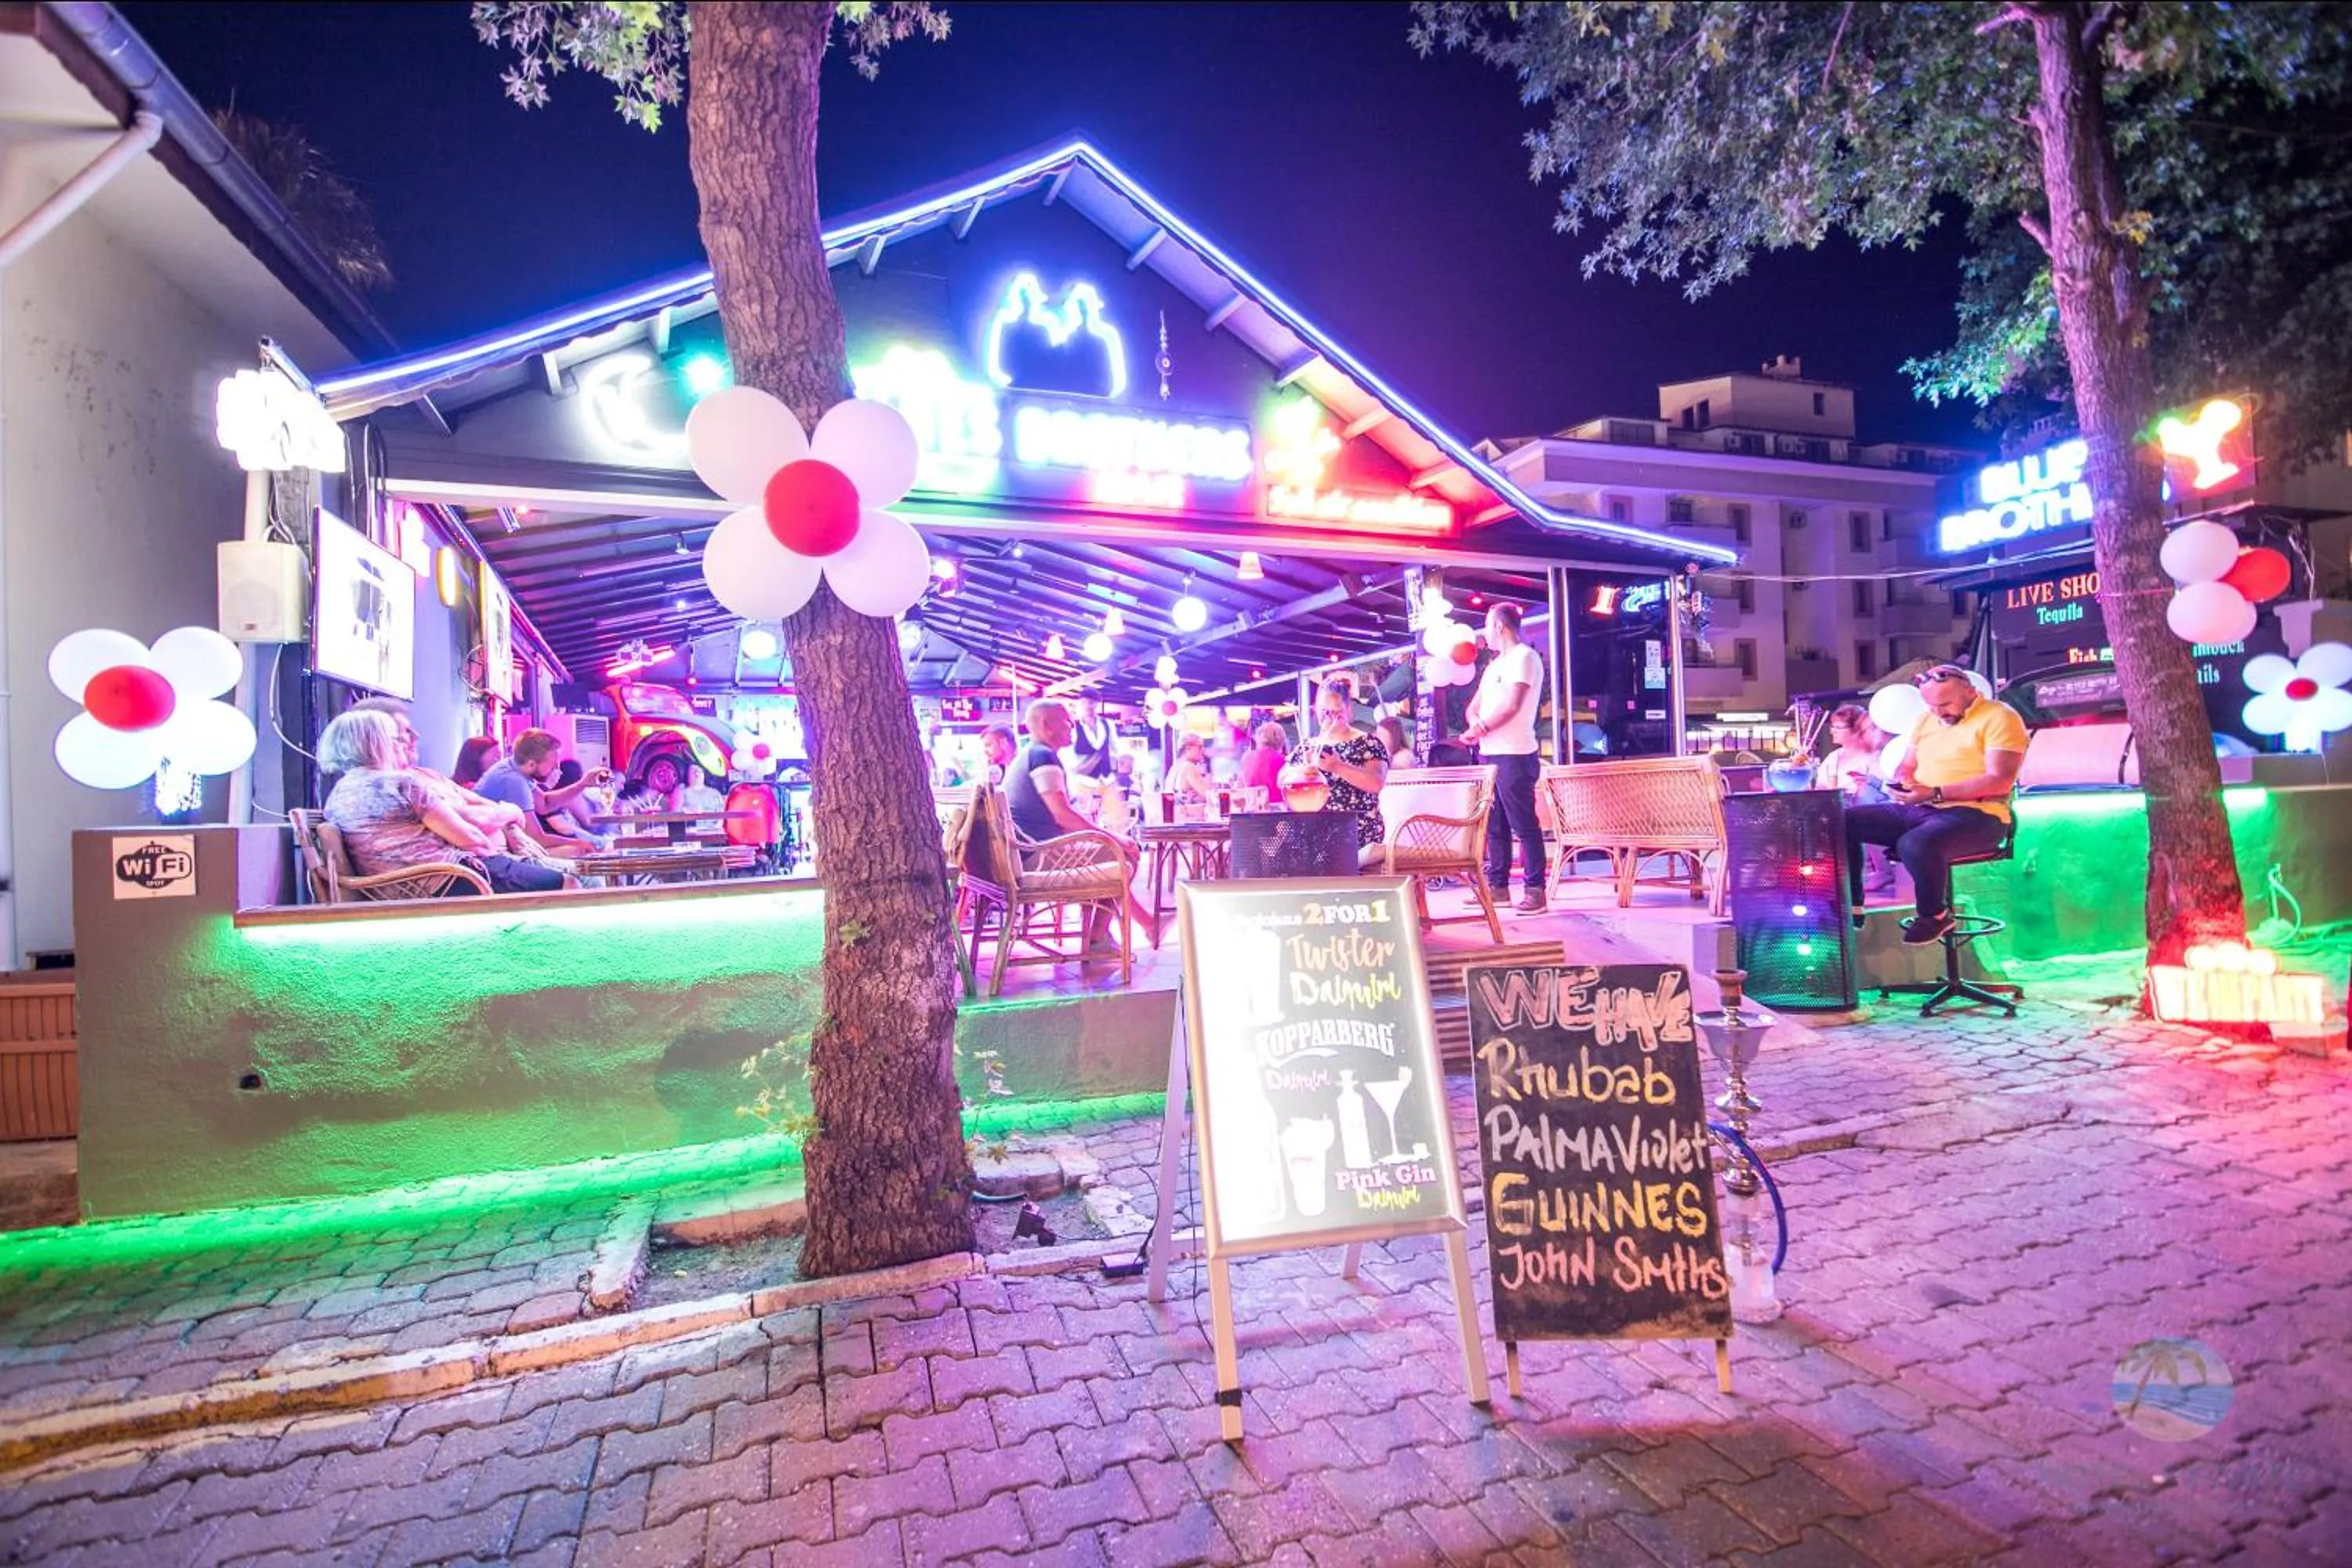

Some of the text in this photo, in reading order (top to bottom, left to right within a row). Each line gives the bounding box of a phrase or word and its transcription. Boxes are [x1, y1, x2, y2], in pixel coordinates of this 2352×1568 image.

[1942, 483, 2093, 551] BROTH
[2007, 572, 2101, 608] LIVE SHO
[2037, 602, 2083, 625] Tequila
[142, 846, 166, 855] FREE
[1286, 927, 1395, 972] Twister
[1476, 967, 1693, 1051] WE HAVE
[1255, 1018, 1396, 1068] KOPPARBERG
[1477, 1037, 1677, 1105] Rhubab
[1335, 1164, 1436, 1191] Pink Gin
[1492, 1172, 1708, 1237] GUINNES
